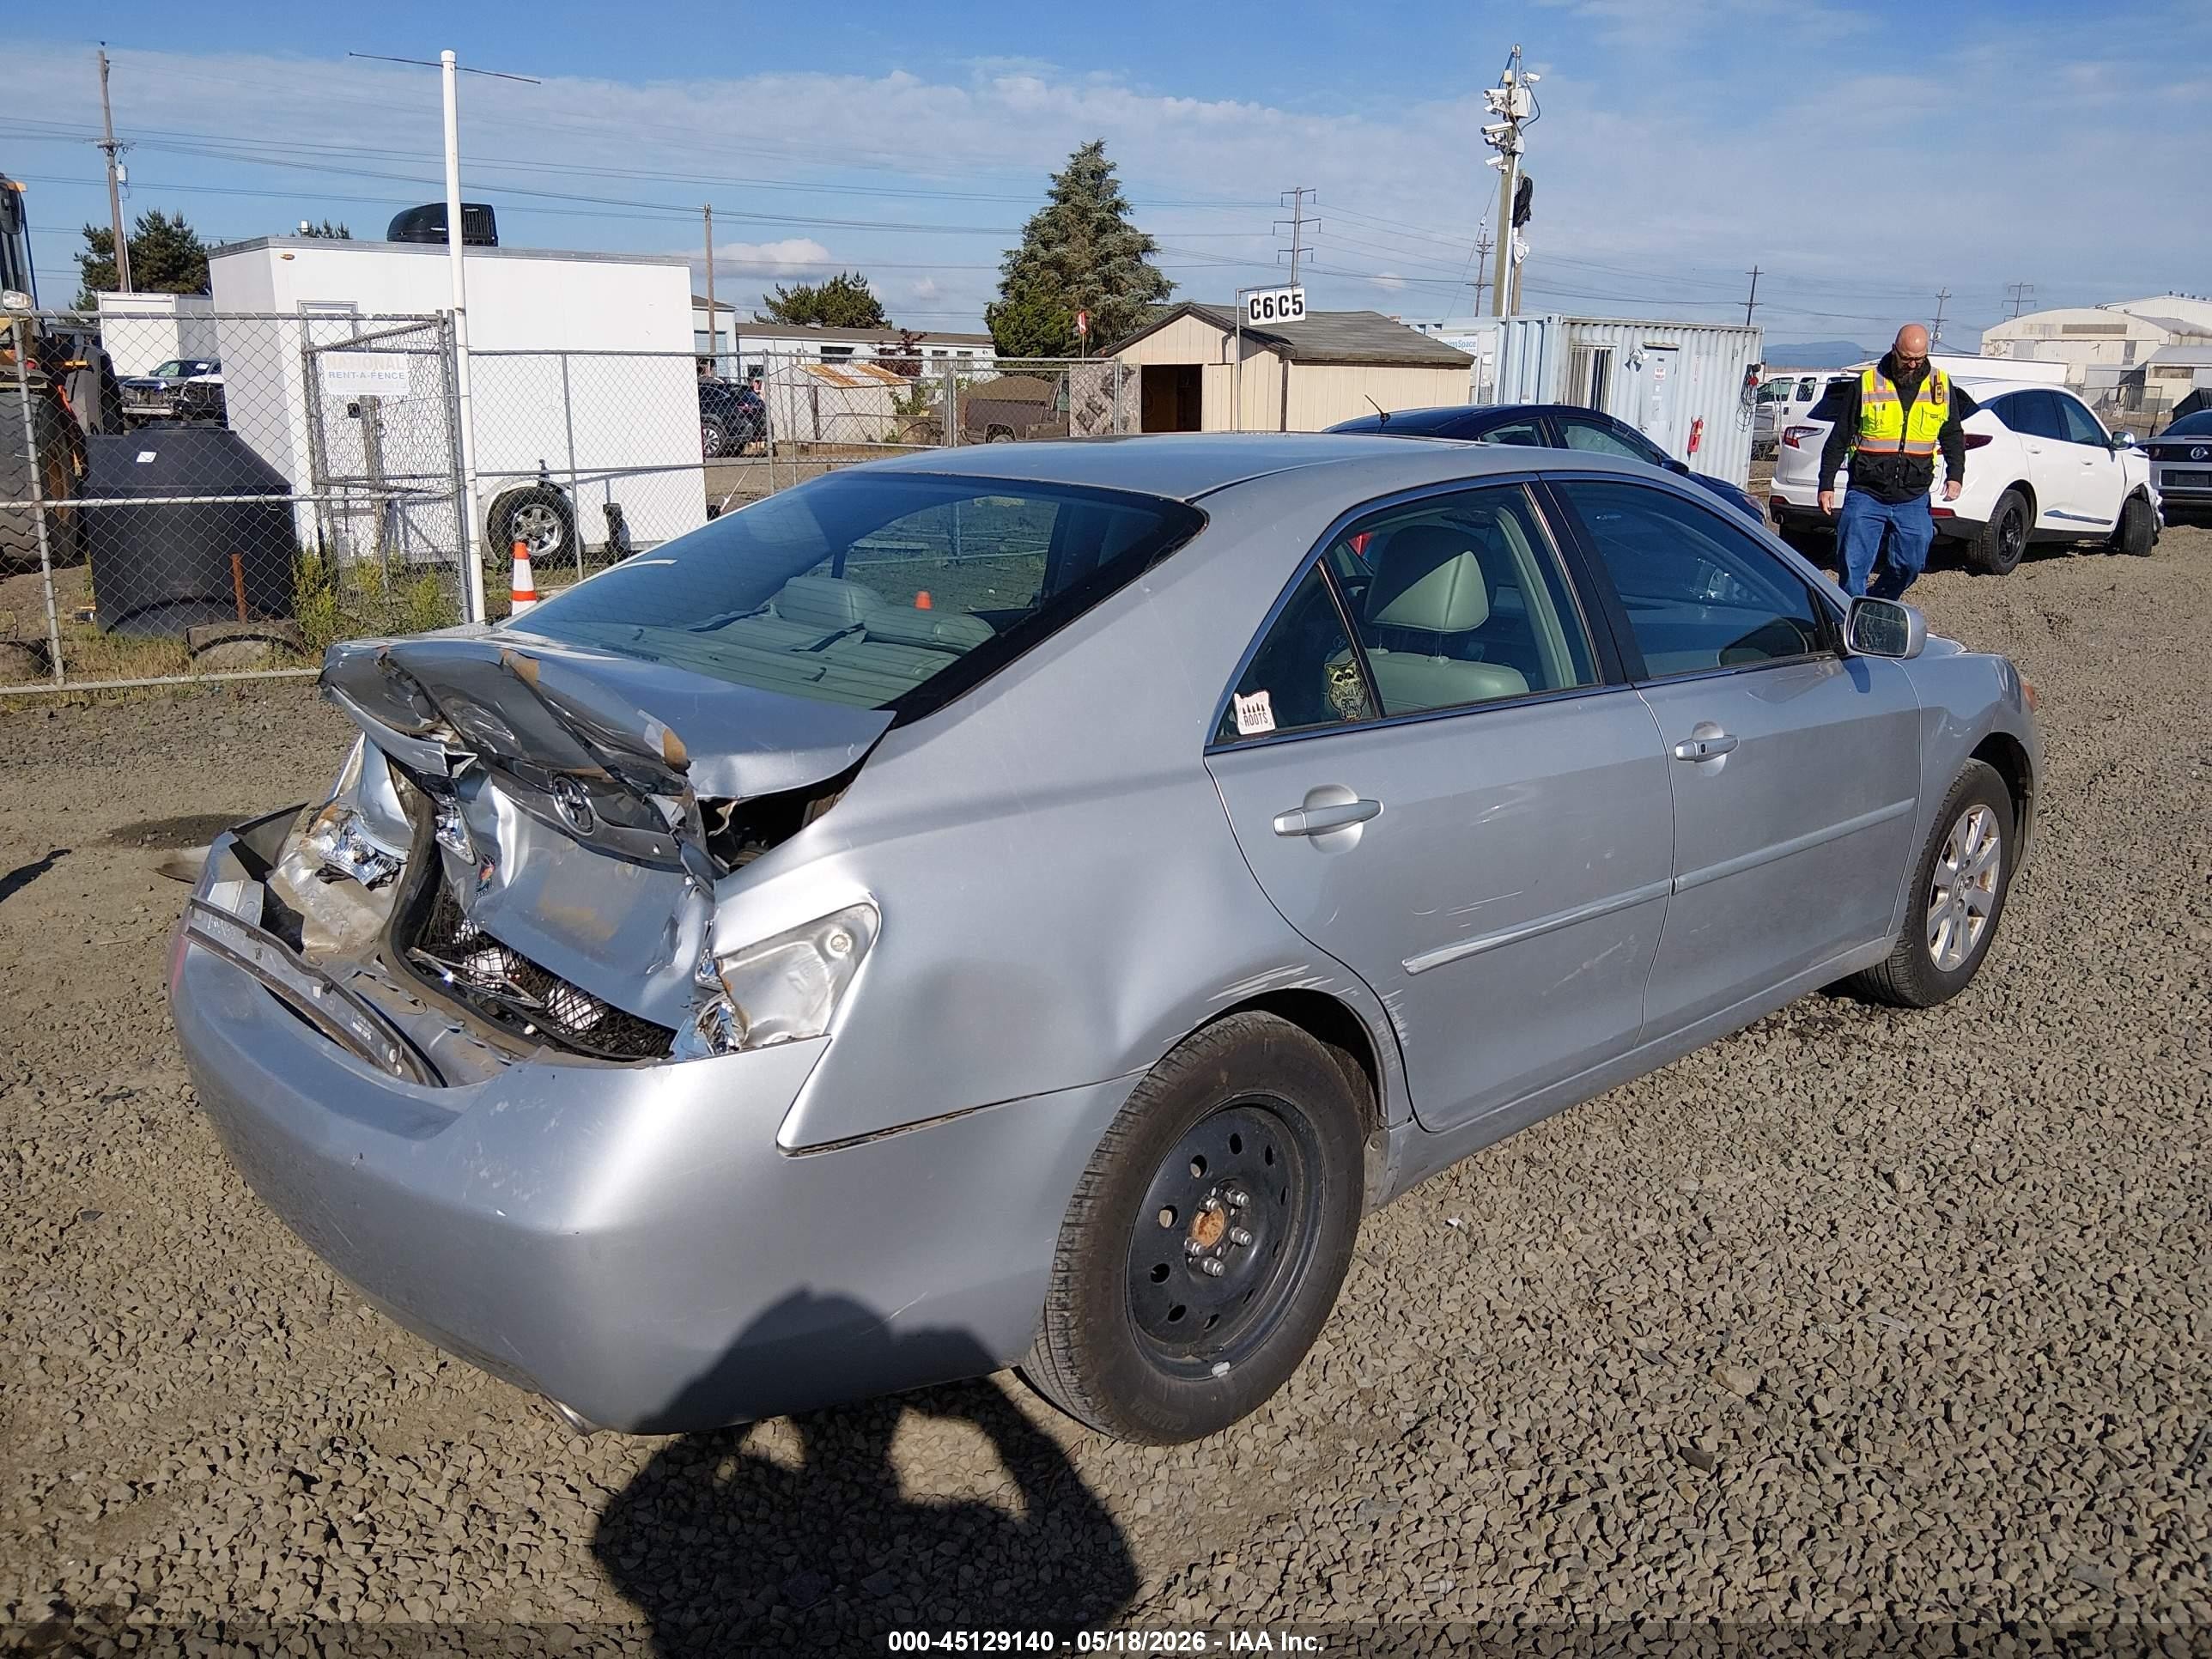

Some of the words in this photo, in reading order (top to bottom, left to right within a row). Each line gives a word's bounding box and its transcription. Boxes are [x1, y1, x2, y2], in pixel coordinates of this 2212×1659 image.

[1250, 297, 1273, 319] C6
[1279, 294, 1303, 317] C5
[325, 355, 406, 370] NATIONAL
[328, 371, 405, 380] RENT-A-FENCE
[1243, 713, 1267, 726] ROOTS
